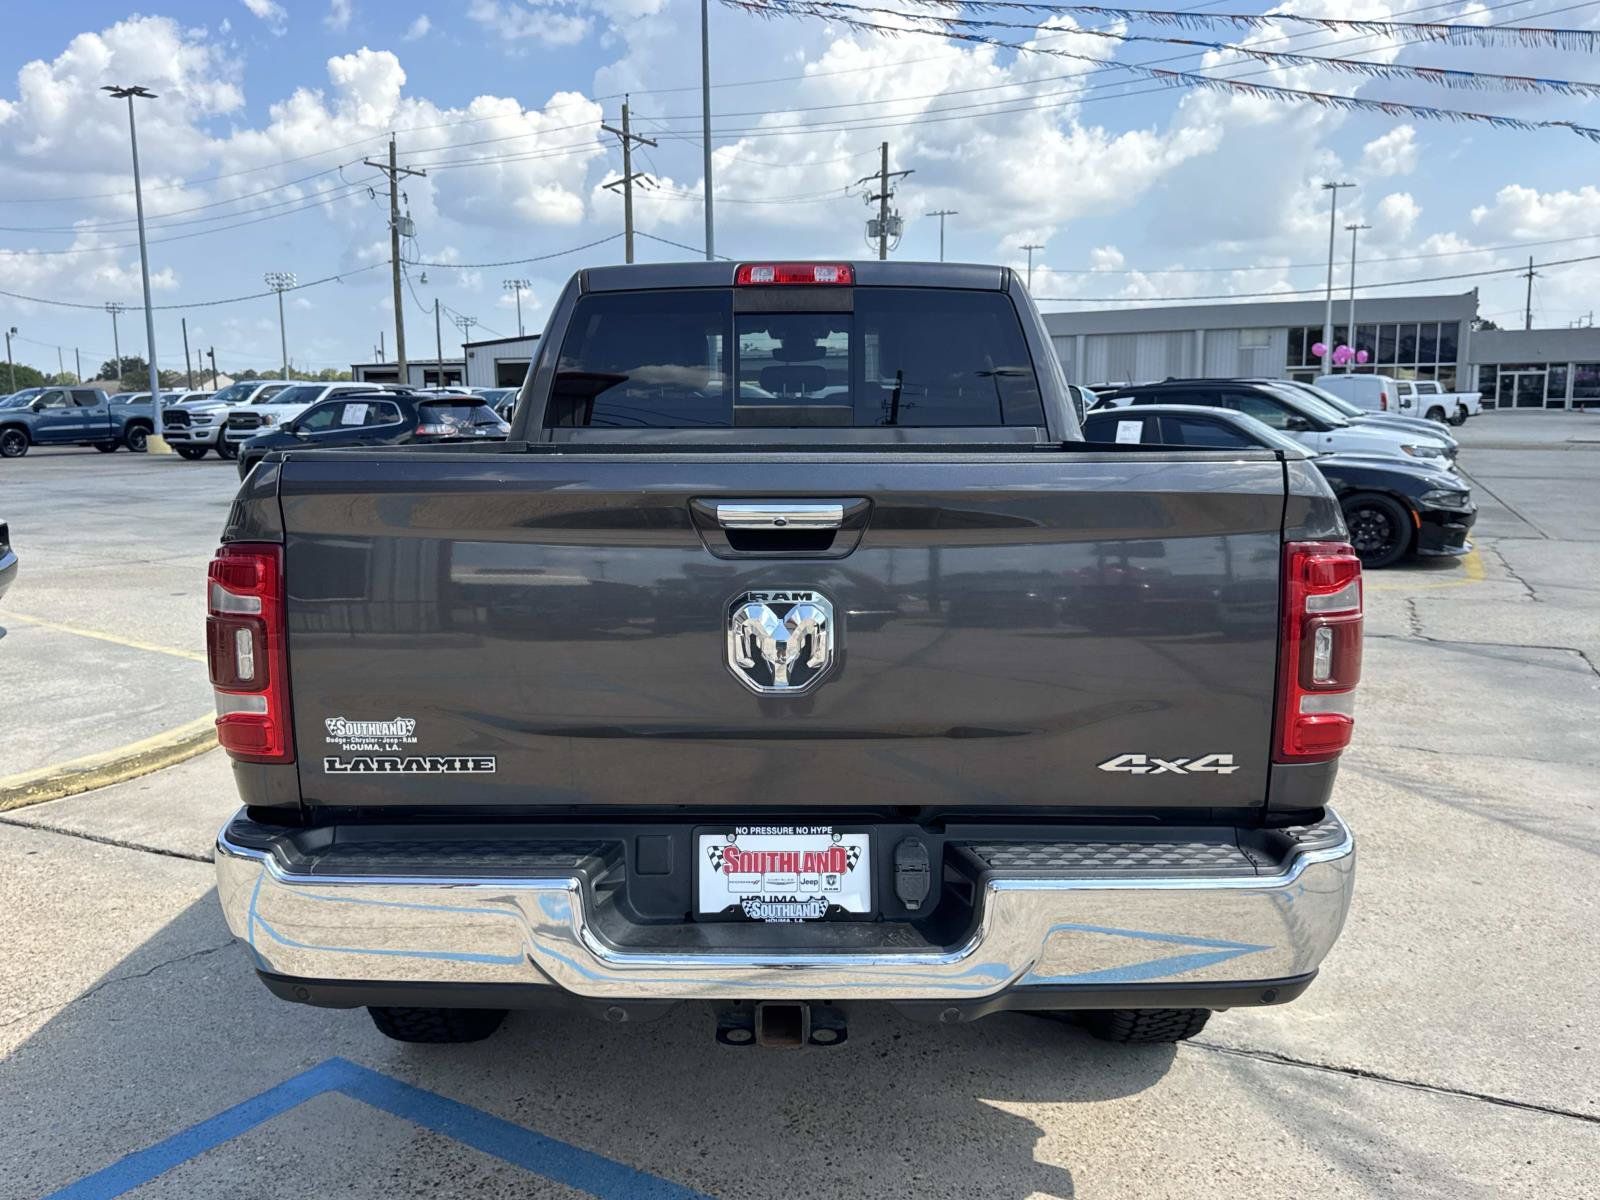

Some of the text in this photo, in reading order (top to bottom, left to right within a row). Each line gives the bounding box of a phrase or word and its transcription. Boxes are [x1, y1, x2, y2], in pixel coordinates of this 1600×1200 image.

[748, 592, 813, 601] RAM
[336, 720, 407, 736] SOUTHLAND
[342, 744, 383, 752] HOUMA,
[323, 756, 496, 774] LARAMIE
[1097, 754, 1240, 774] 4x4
[735, 826, 833, 835] NO PRESSURE NO HYPE
[723, 846, 847, 874] SOUTHLAND
[800, 878, 819, 886] Jeep
[751, 901, 819, 918] SOUTHLAND
